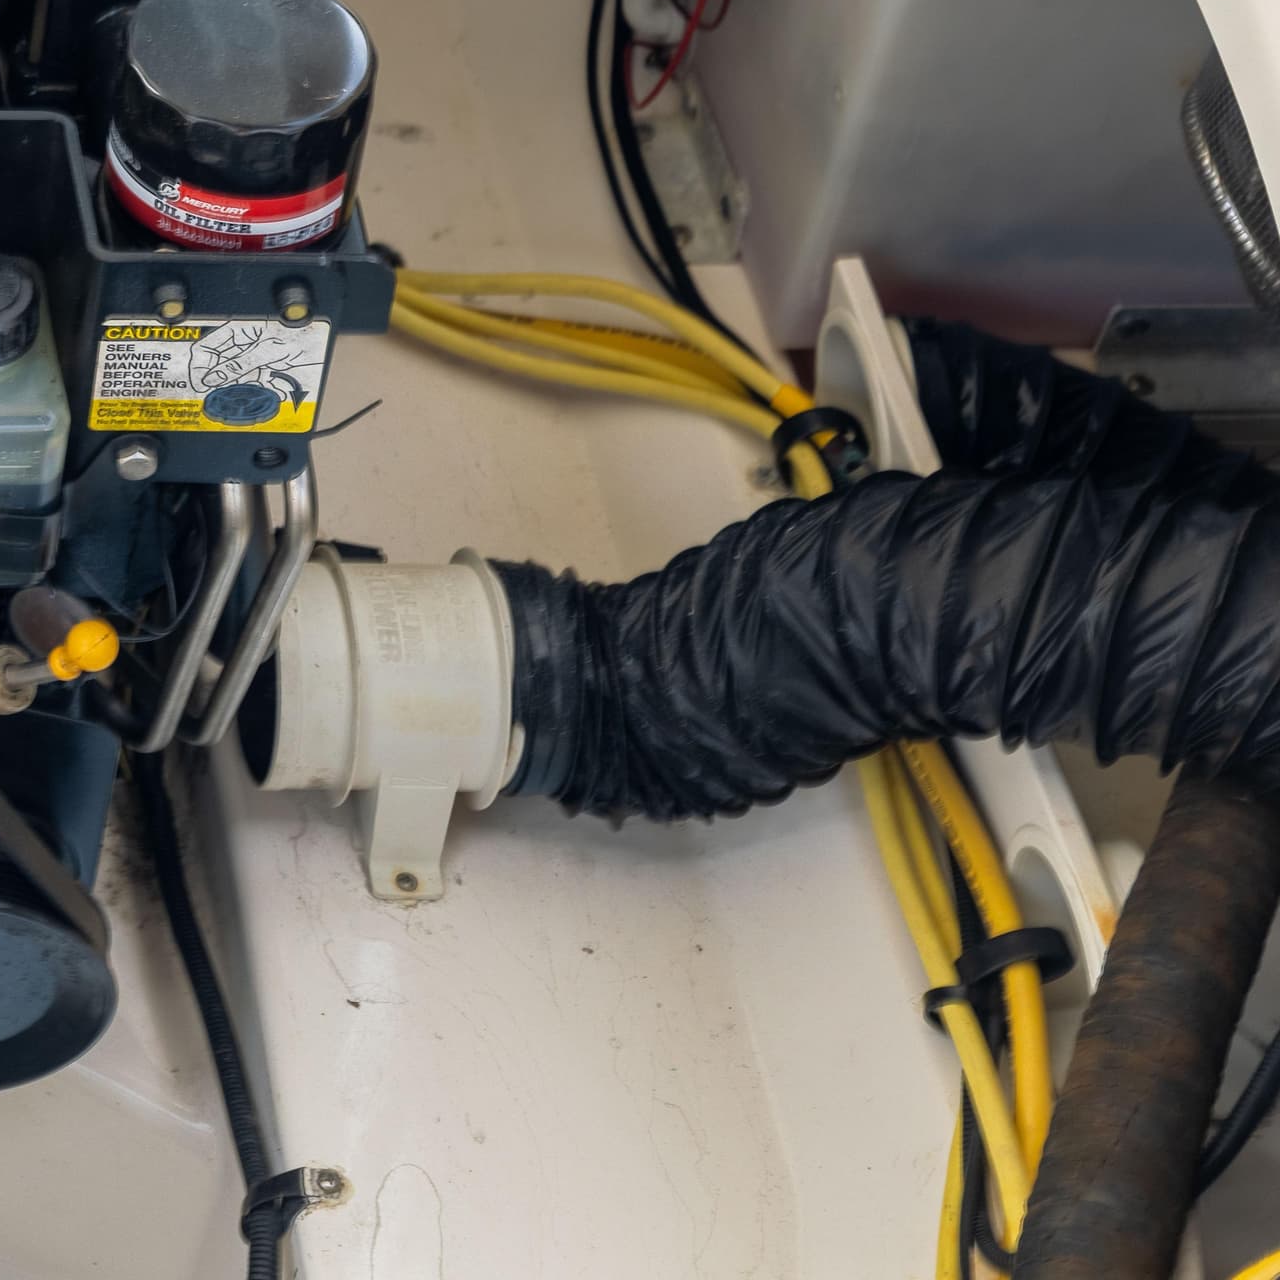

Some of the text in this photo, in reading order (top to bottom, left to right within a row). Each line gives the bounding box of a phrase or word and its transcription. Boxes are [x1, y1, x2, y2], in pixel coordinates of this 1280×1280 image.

[183, 196, 250, 216] MERCURY
[155, 199, 181, 219] OIL
[186, 215, 252, 234] FILTER
[105, 327, 201, 340] CAUTION
[106, 344, 135, 352] SEE
[105, 353, 172, 361] OWNERS
[104, 362, 168, 370] MANUAL
[103, 371, 164, 379] BEFORE
[101, 380, 187, 389] OPERATING
[100, 389, 158, 398] ENGINE
[97, 408, 201, 418] Close This Valve
